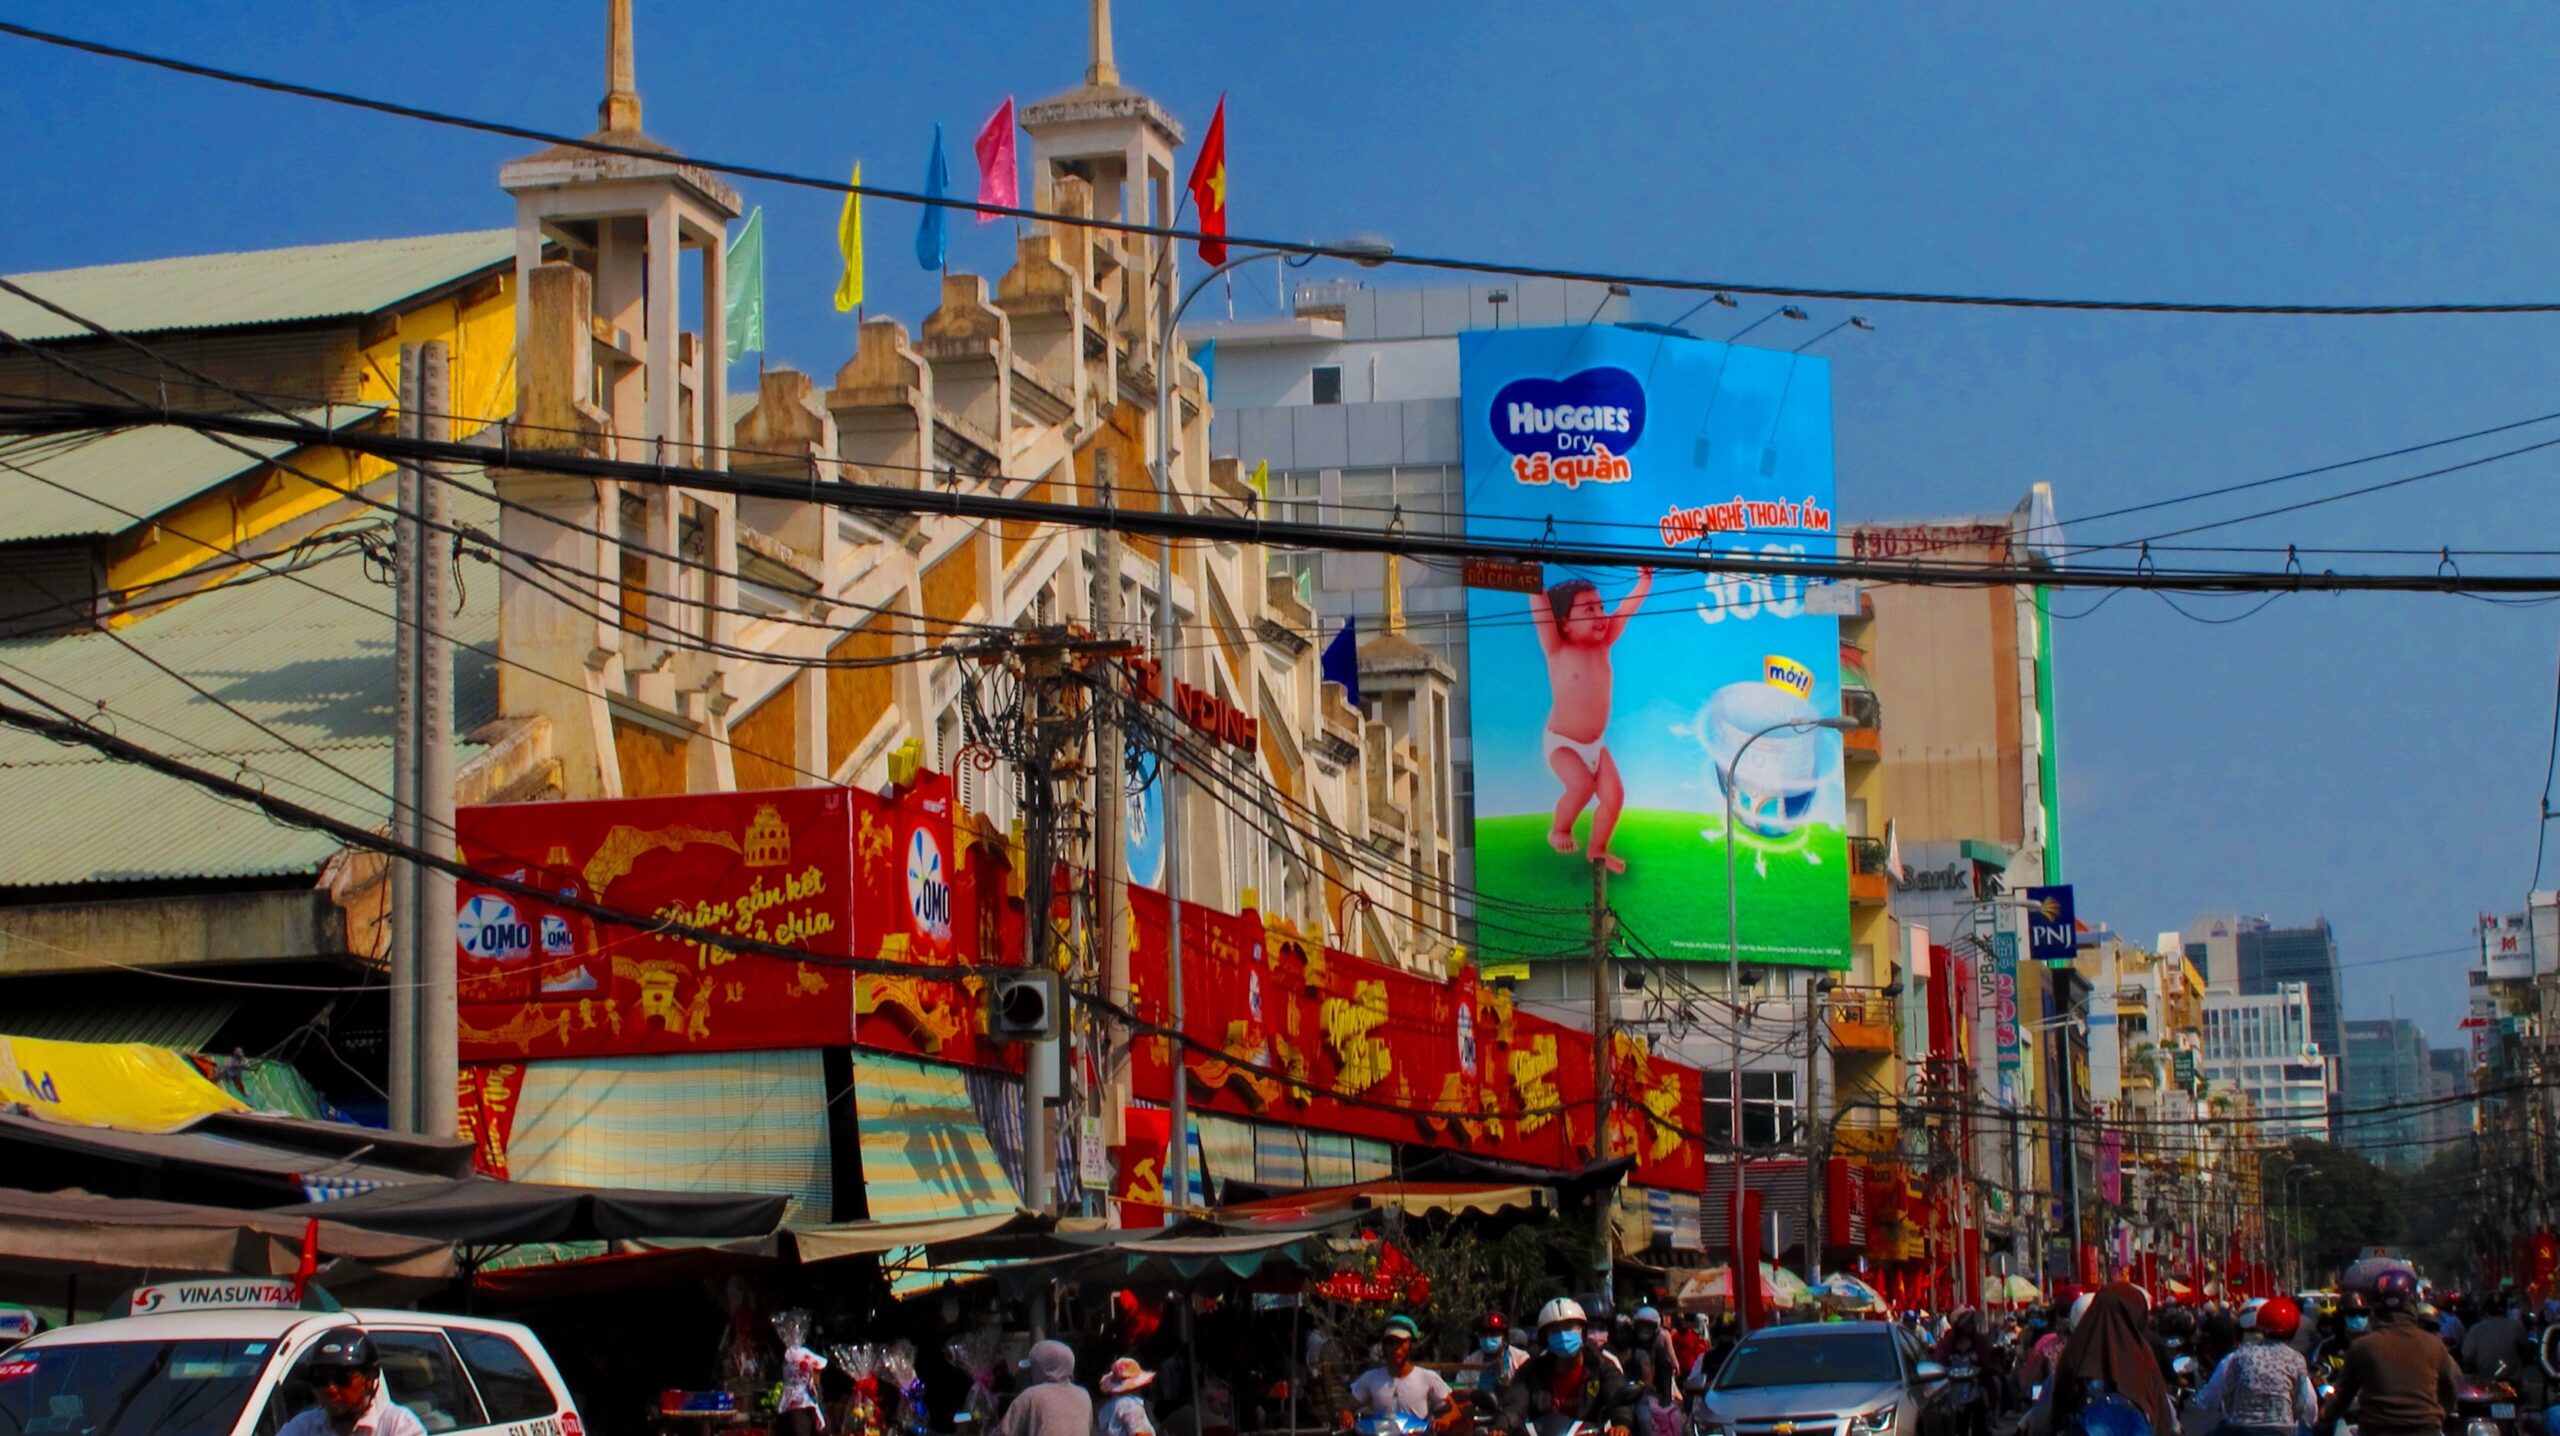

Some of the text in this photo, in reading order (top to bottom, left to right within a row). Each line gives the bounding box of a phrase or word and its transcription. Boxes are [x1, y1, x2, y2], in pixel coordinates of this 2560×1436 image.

[1558, 433, 1594, 452] Dry
[1514, 444, 1630, 489] tã quần
[1660, 504, 1706, 546] CÔNG
[1707, 496, 1745, 535] NGHỆ
[1769, 667, 1809, 692] mới!
[785, 865, 826, 902] kết
[1897, 862, 1967, 891] Bank
[921, 878, 951, 926] OMO
[481, 924, 532, 951] OMO
[547, 930, 574, 947] OMO
[775, 908, 835, 946] chia
[2032, 923, 2073, 950] PNJ
